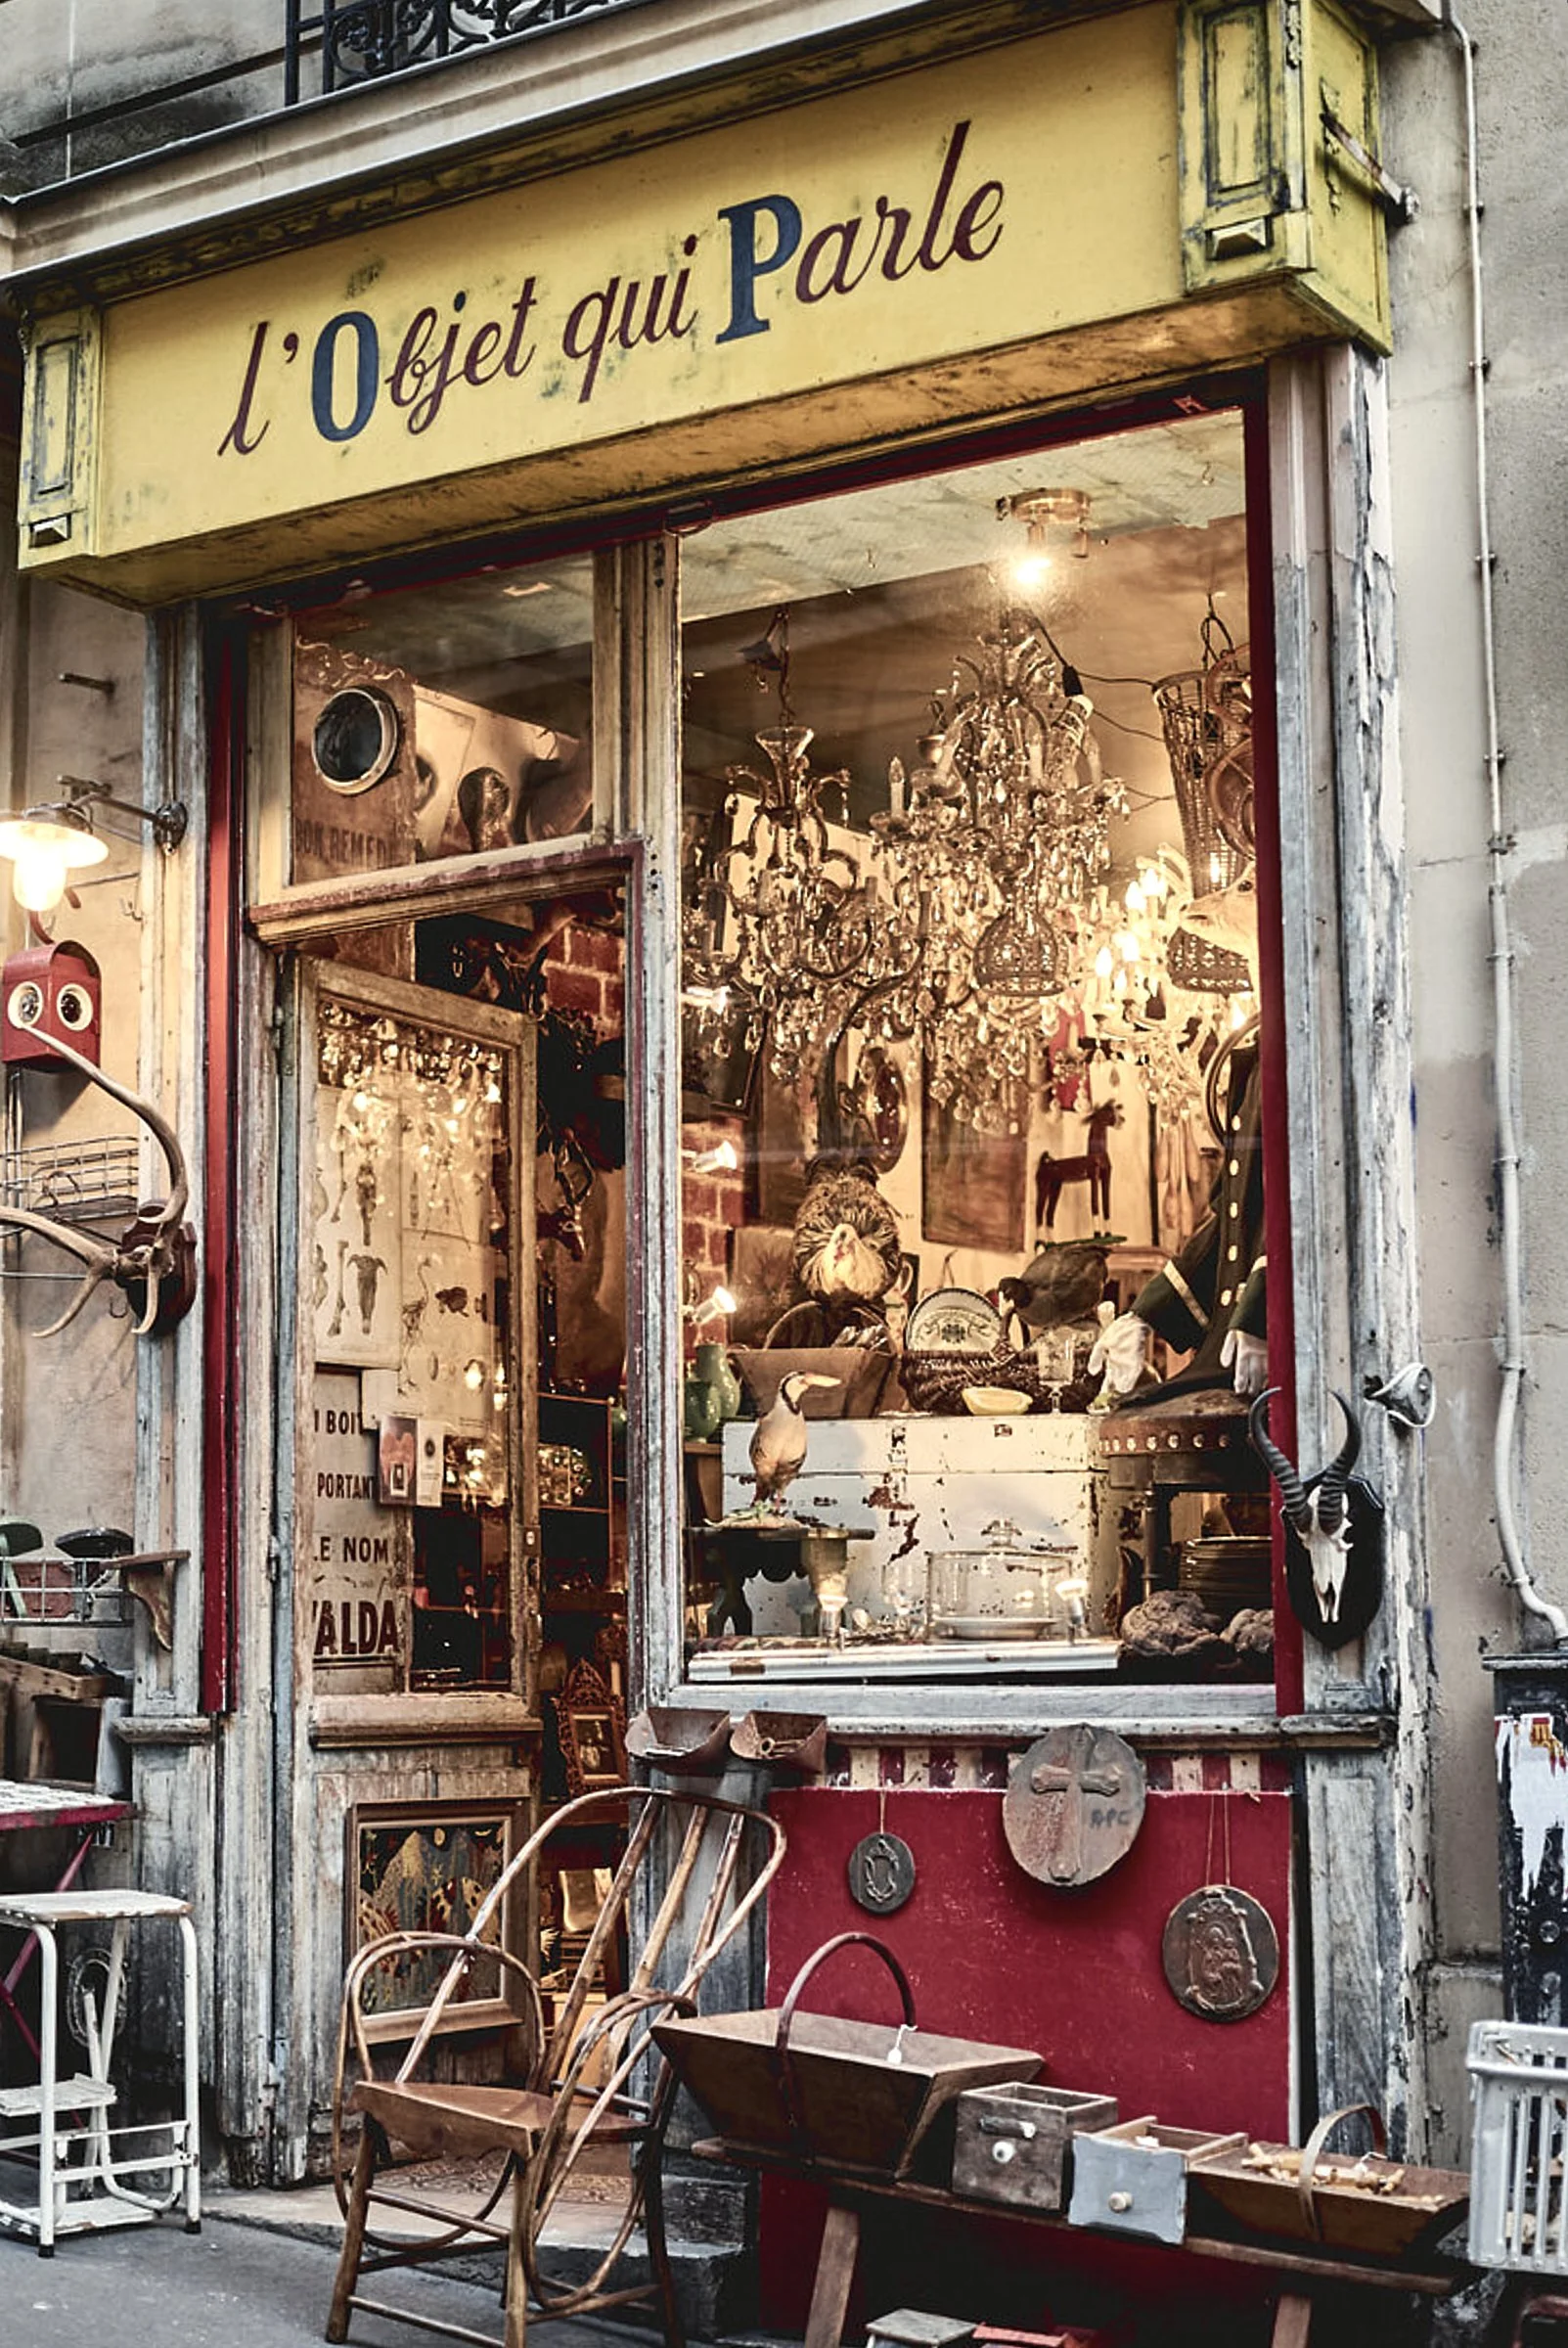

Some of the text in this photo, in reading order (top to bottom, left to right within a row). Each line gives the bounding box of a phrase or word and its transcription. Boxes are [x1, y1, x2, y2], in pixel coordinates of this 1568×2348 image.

[562, 234, 698, 403] qui
[715, 119, 1004, 344] Parle
[313, 1537, 388, 1563] E NOM
